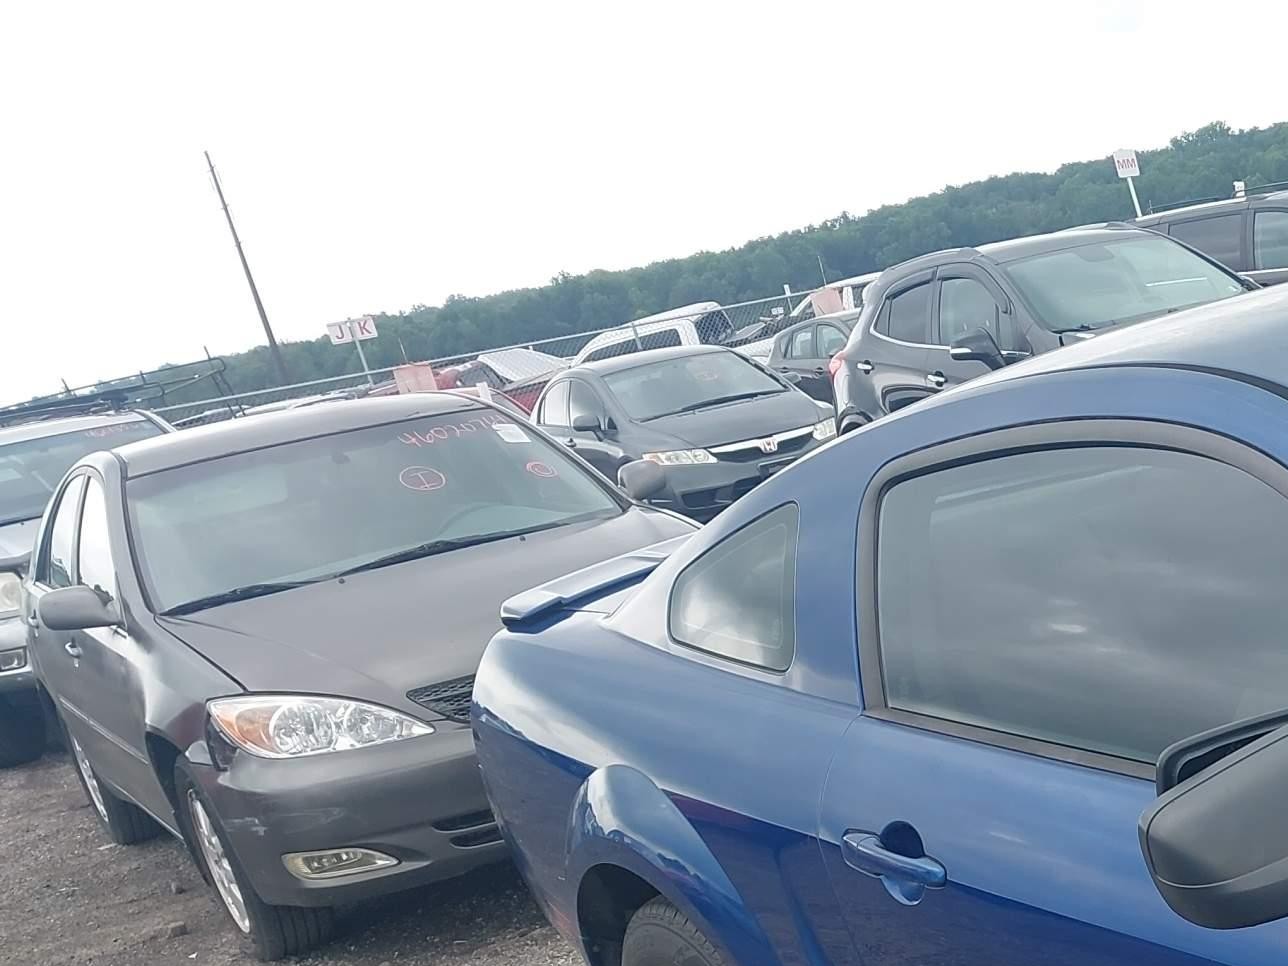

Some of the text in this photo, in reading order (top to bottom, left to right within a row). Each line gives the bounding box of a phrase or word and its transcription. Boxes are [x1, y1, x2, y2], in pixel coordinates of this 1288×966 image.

[1116, 158, 1136, 170] MM
[335, 319, 372, 340] J K
